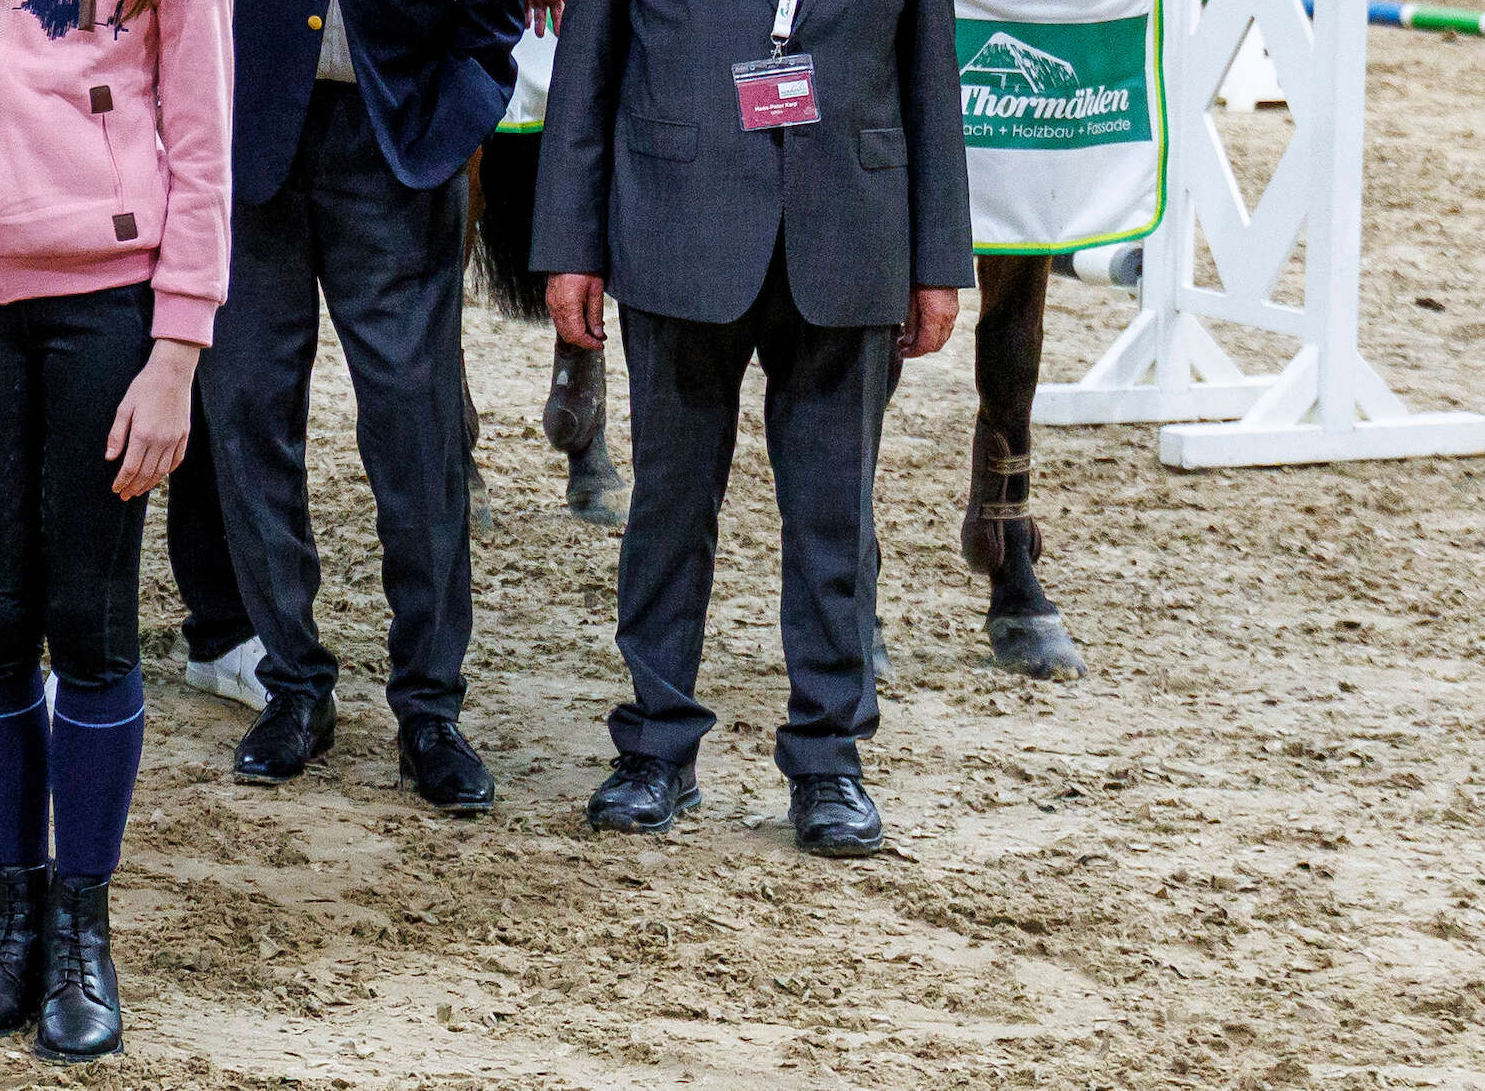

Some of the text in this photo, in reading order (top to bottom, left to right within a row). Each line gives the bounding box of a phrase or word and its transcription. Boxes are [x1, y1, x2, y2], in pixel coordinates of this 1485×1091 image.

[961, 84, 1130, 120] Thormählen
[963, 124, 993, 137] ach
[1012, 125, 1074, 139] Holzbau
[1087, 118, 1131, 135] Fassade
